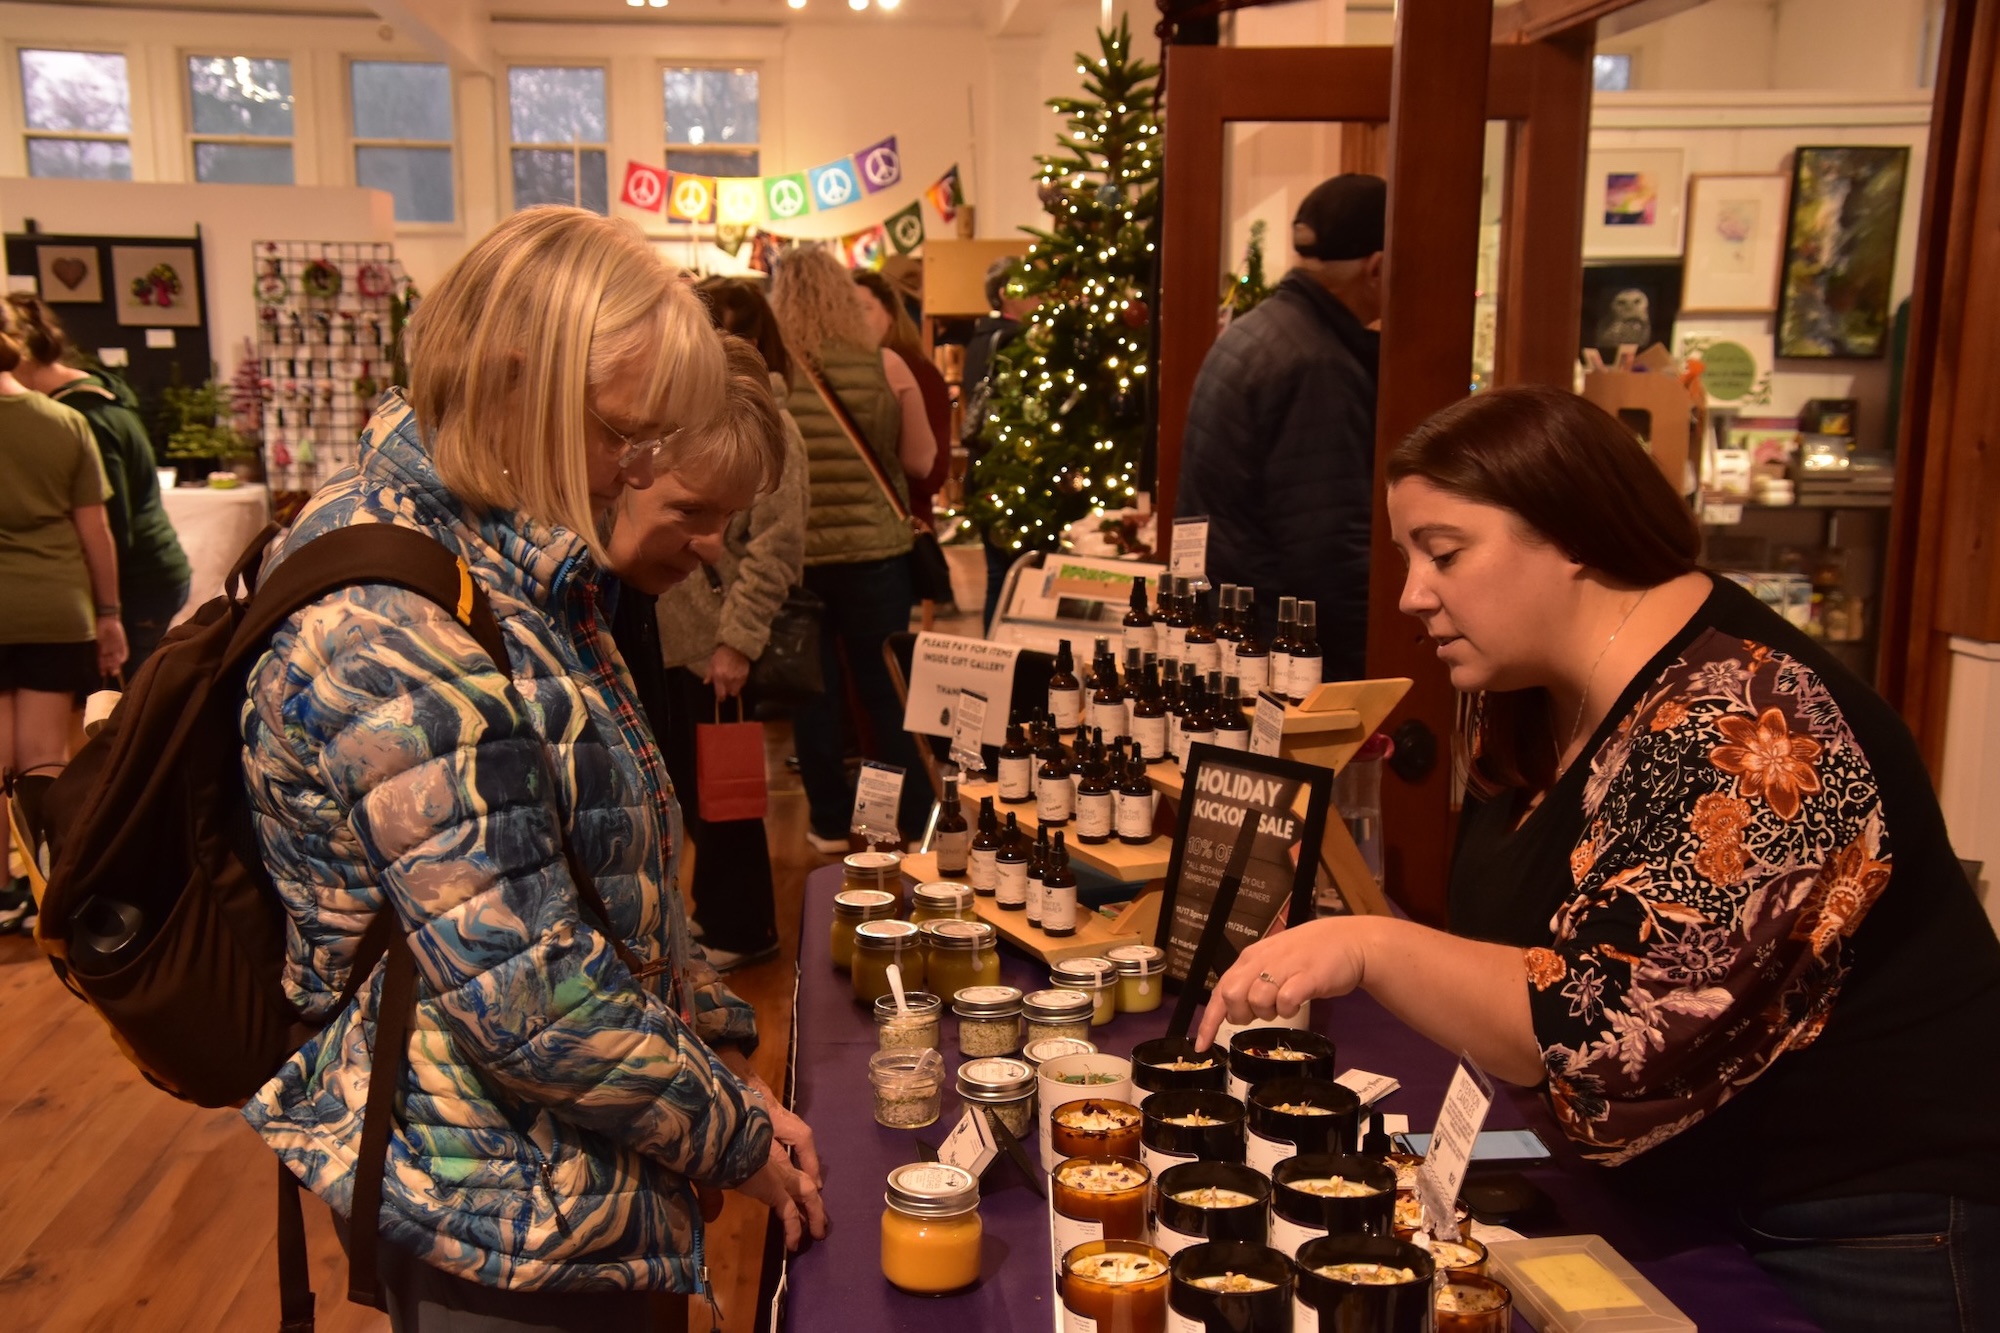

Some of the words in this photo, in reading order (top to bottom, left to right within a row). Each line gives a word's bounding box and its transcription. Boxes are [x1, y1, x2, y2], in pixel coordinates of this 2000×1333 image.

[922, 637, 951, 650] PLEASE
[952, 641, 968, 652] PAY
[970, 643, 987, 654] FOR
[989, 646, 1013, 659] ITEMS
[923, 652, 949, 664] INSIDE
[951, 656, 969, 667] GIFT
[970, 659, 1006, 672] GALLERY
[937, 684, 961, 697] THAN
[1195, 766, 1283, 807] HOLIDAY
[1194, 799, 1246, 828] KICKOF
[1257, 813, 1294, 840] SALE
[1187, 836, 1213, 860] 10%
[1215, 843, 1234, 864] OF
[1199, 864, 1225, 877] BOTANIC
[1250, 878, 1266, 889] OILS
[1456, 1089, 1475, 1119] CANDLES
